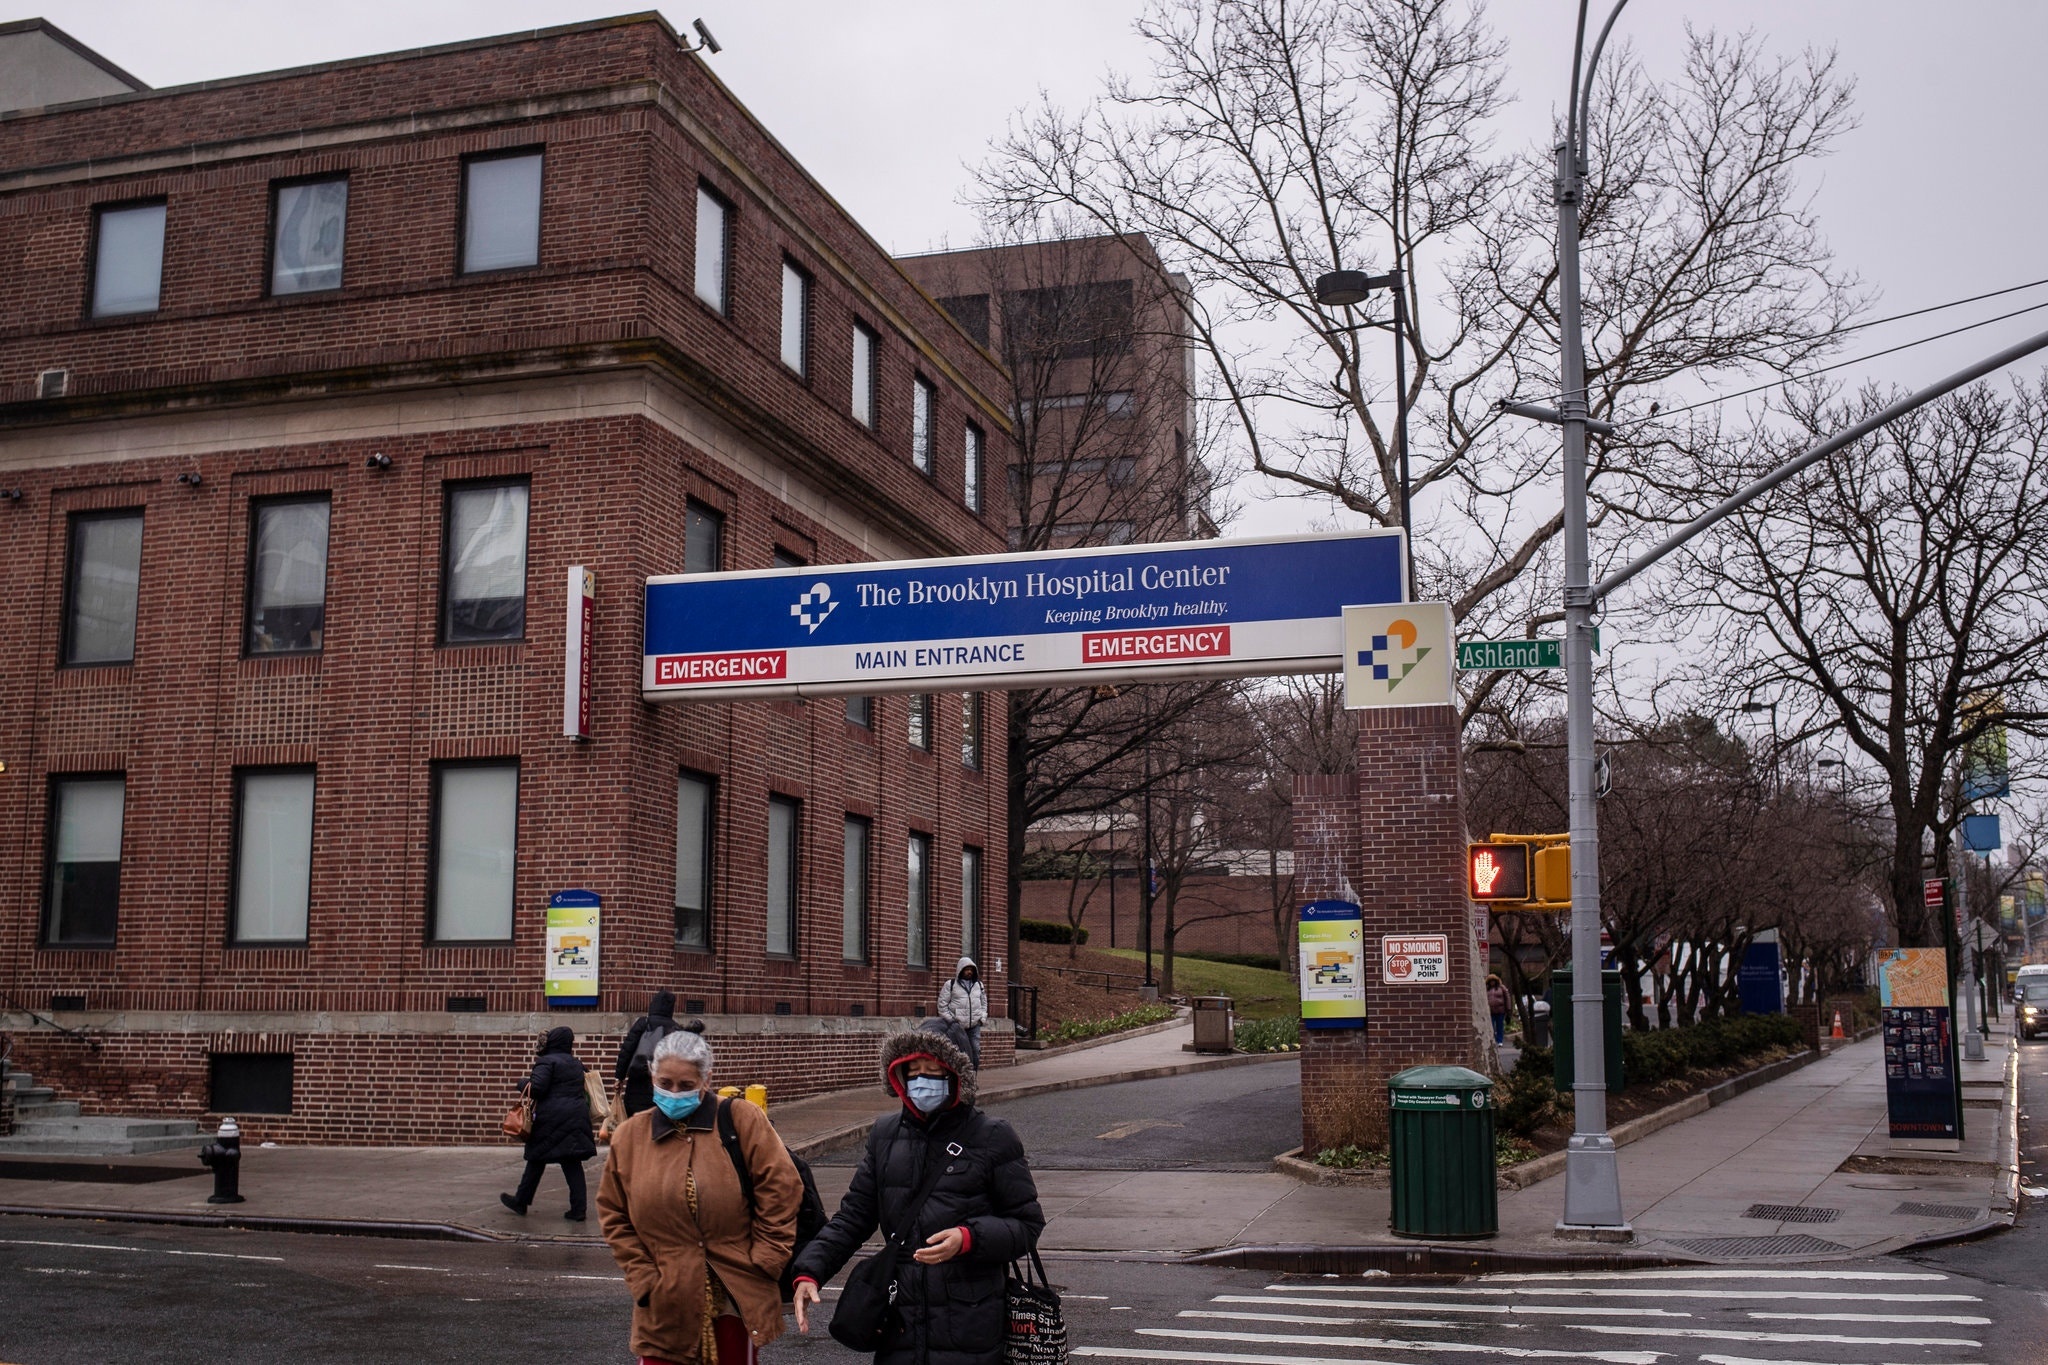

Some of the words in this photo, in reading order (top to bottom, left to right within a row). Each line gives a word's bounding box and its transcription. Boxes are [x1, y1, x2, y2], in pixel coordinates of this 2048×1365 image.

[857, 583, 901, 607] The
[908, 576, 1018, 605] Brooklyn
[1026, 567, 1134, 600] Hospital
[1141, 565, 1230, 590] Center
[1045, 609, 1101, 624] Keeping
[1106, 604, 1168, 620] Brooklyn
[1172, 600, 1228, 616] healthy.
[856, 650, 907, 669] MAIN
[916, 644, 1025, 666] ENTRANCE
[1088, 632, 1224, 658] EMERGENCY
[1463, 643, 1538, 667] Ashland
[1548, 644, 1561, 656] Pl
[582, 608, 590, 726] EMERGENCY
[661, 656, 780, 680] EMERGENCY
[1390, 942, 1400, 953] NO
[1402, 942, 1440, 953] SMOKING
[1012, 1310, 1036, 1320] Times
[1012, 1321, 1036, 1334] York
[1033, 1344, 1055, 1353] New
